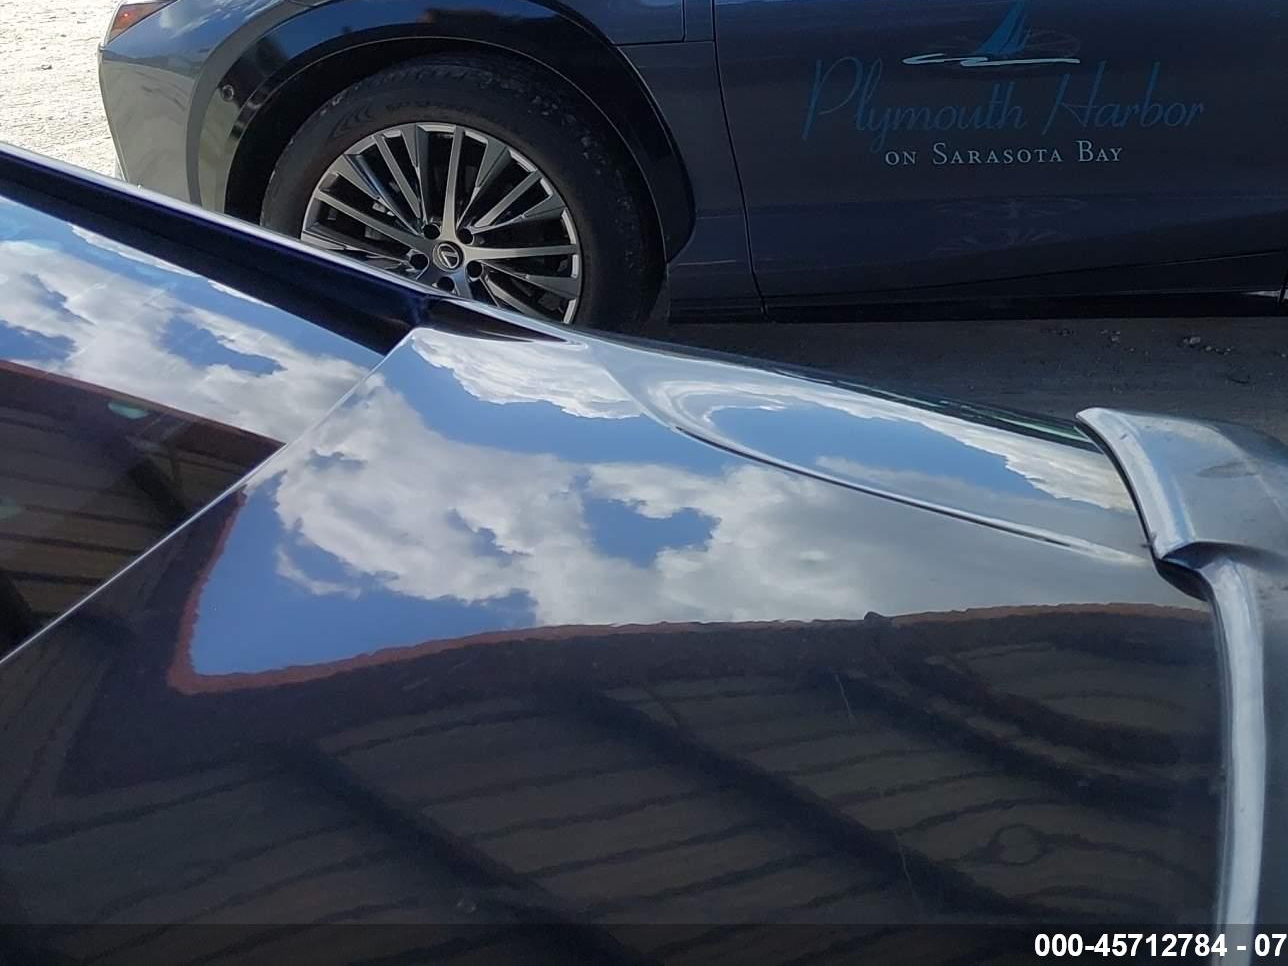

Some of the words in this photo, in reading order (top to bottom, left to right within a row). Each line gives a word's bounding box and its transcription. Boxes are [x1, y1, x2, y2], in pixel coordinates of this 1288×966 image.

[801, 55, 1027, 154] Plymouth
[1041, 59, 1205, 136] Harbor
[932, 141, 1063, 166] SARASOTA
[1075, 140, 1123, 163] BAY
